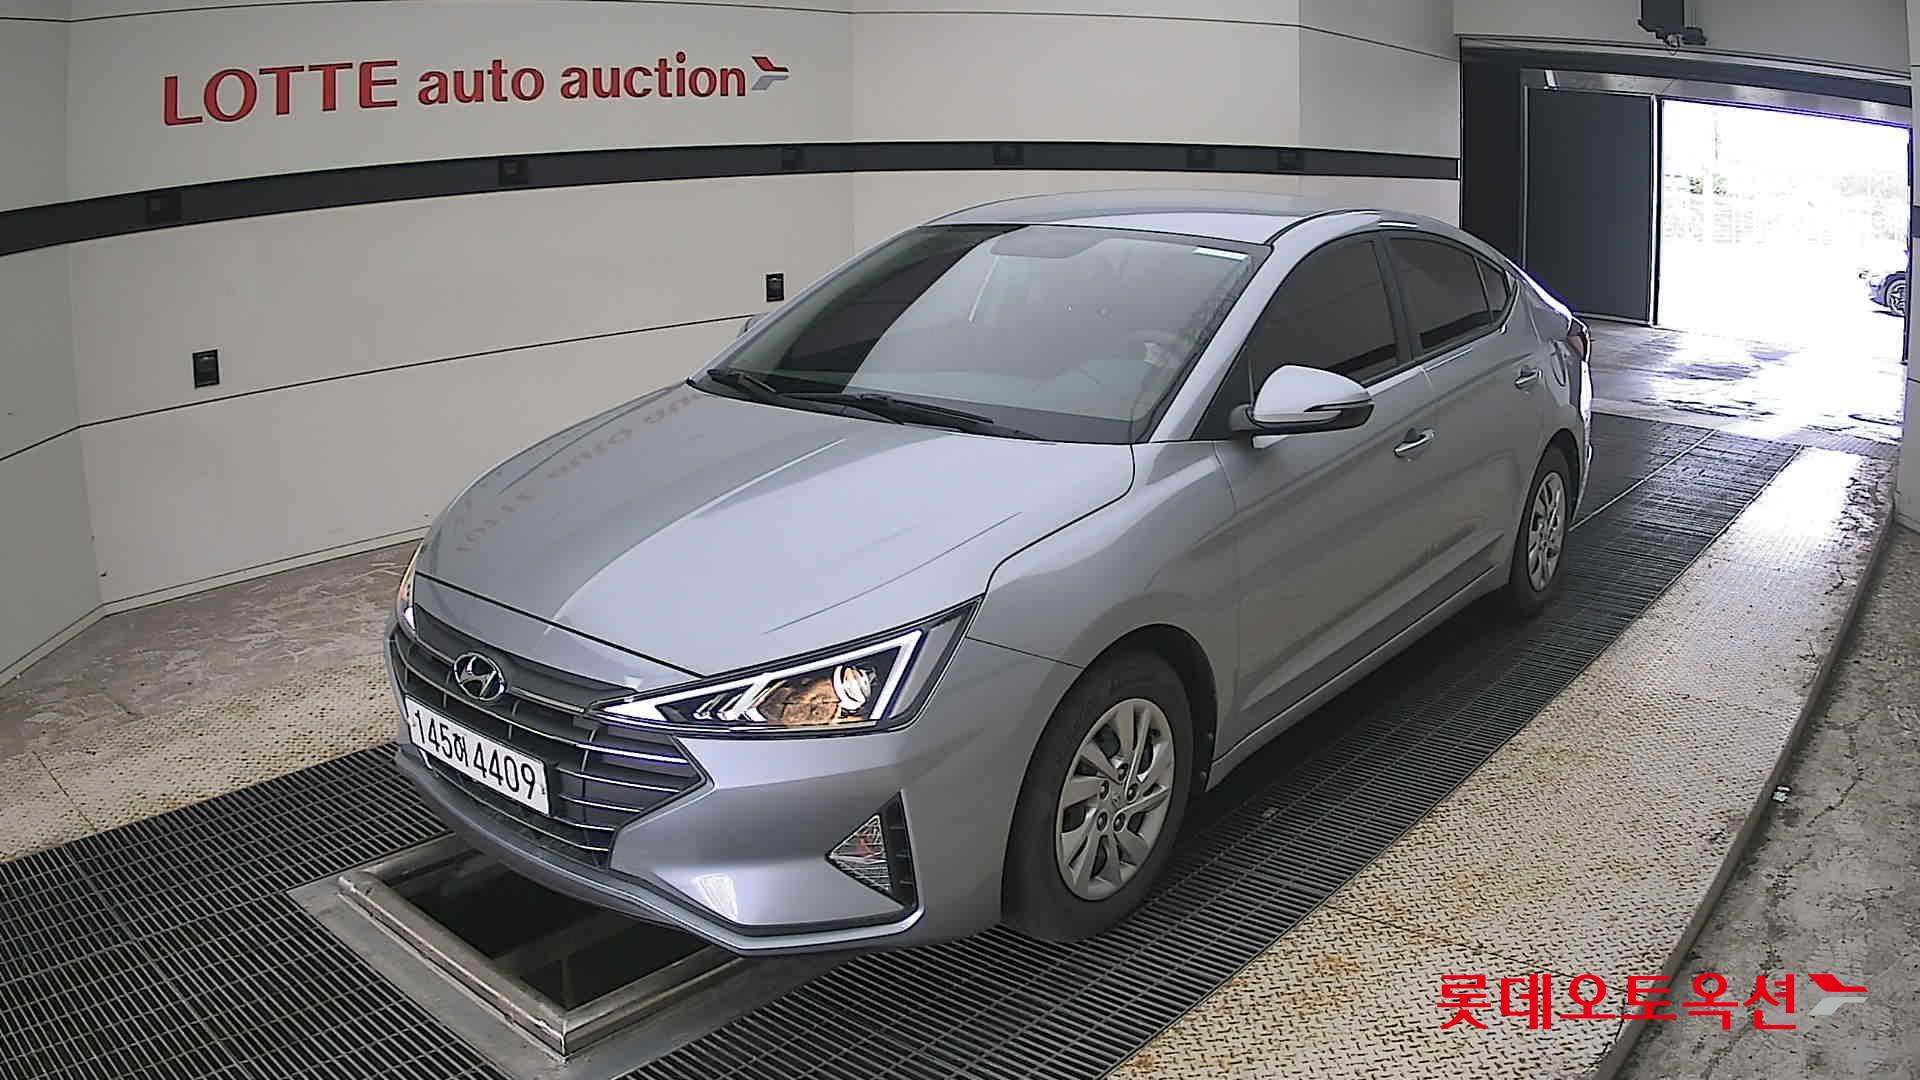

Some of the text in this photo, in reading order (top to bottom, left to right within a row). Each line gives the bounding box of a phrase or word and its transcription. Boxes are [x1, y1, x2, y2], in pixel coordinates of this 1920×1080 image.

[163, 50, 747, 127] LOTTE auto auction
